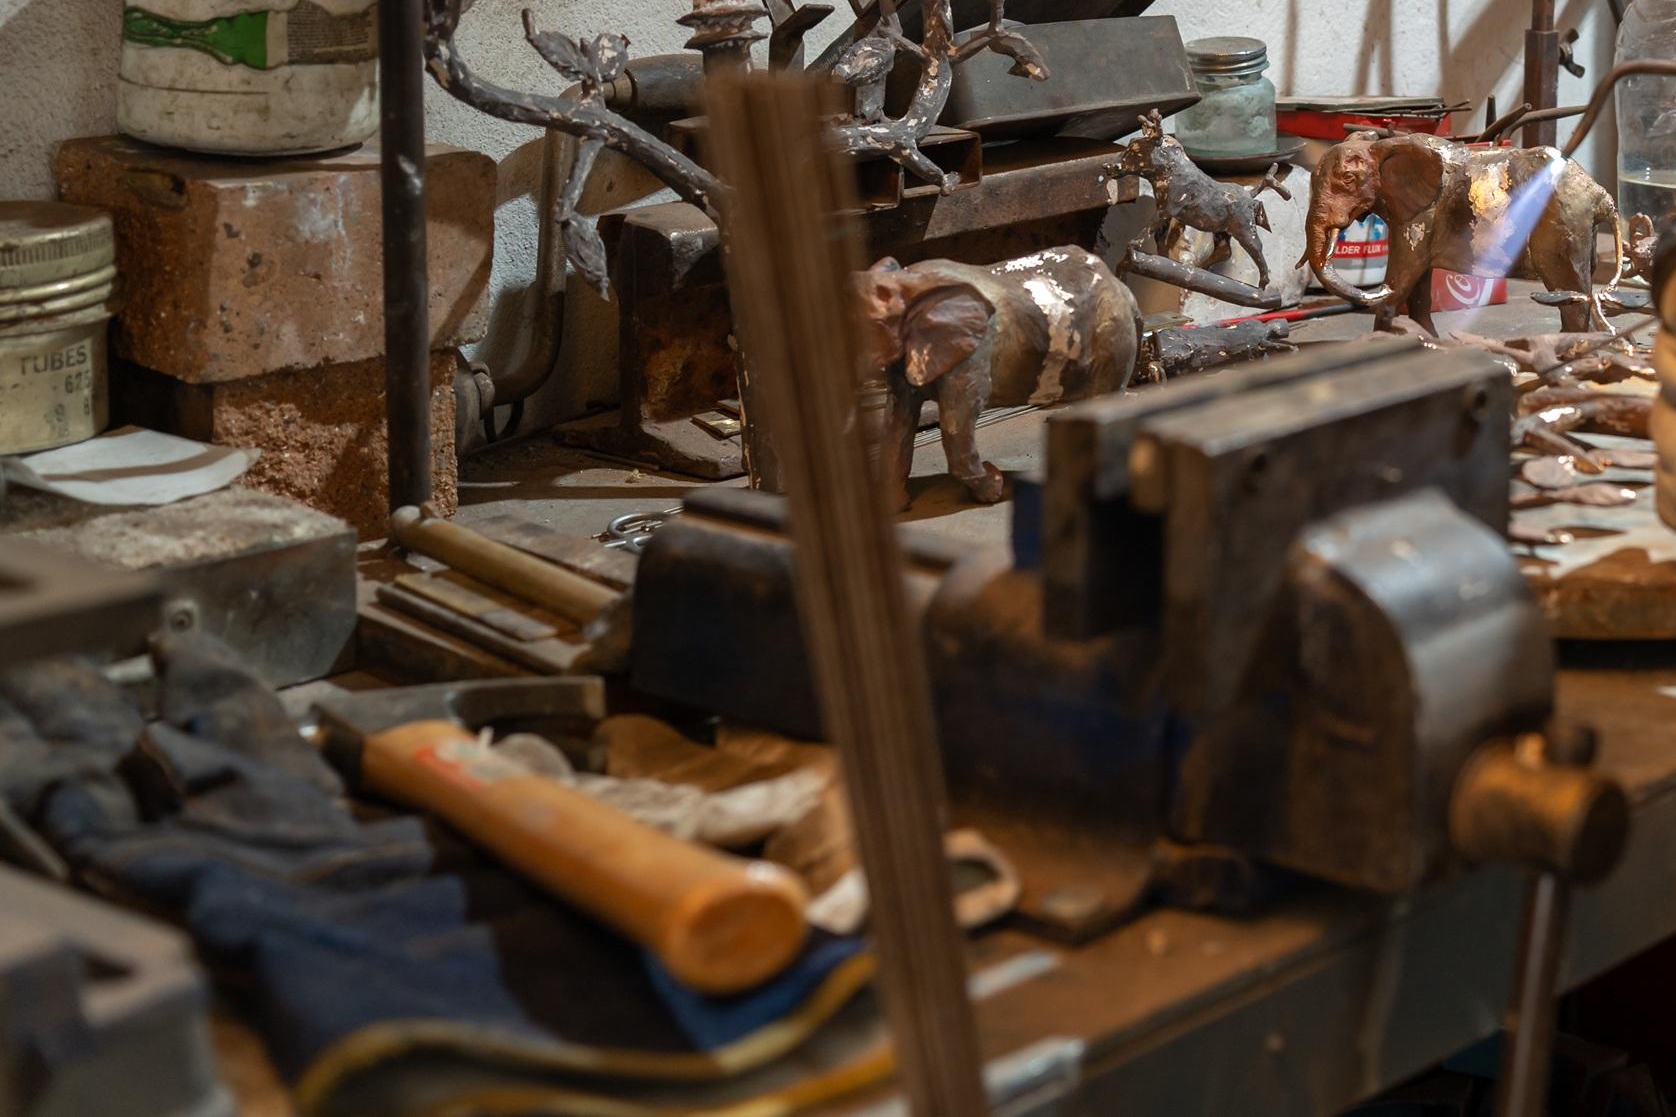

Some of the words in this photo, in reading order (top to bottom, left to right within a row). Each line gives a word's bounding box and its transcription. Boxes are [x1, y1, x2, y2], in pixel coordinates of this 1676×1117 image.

[1335, 245, 1361, 254] LDER
[1363, 244, 1381, 253] FLUX
[20, 344, 87, 376] TUBES
